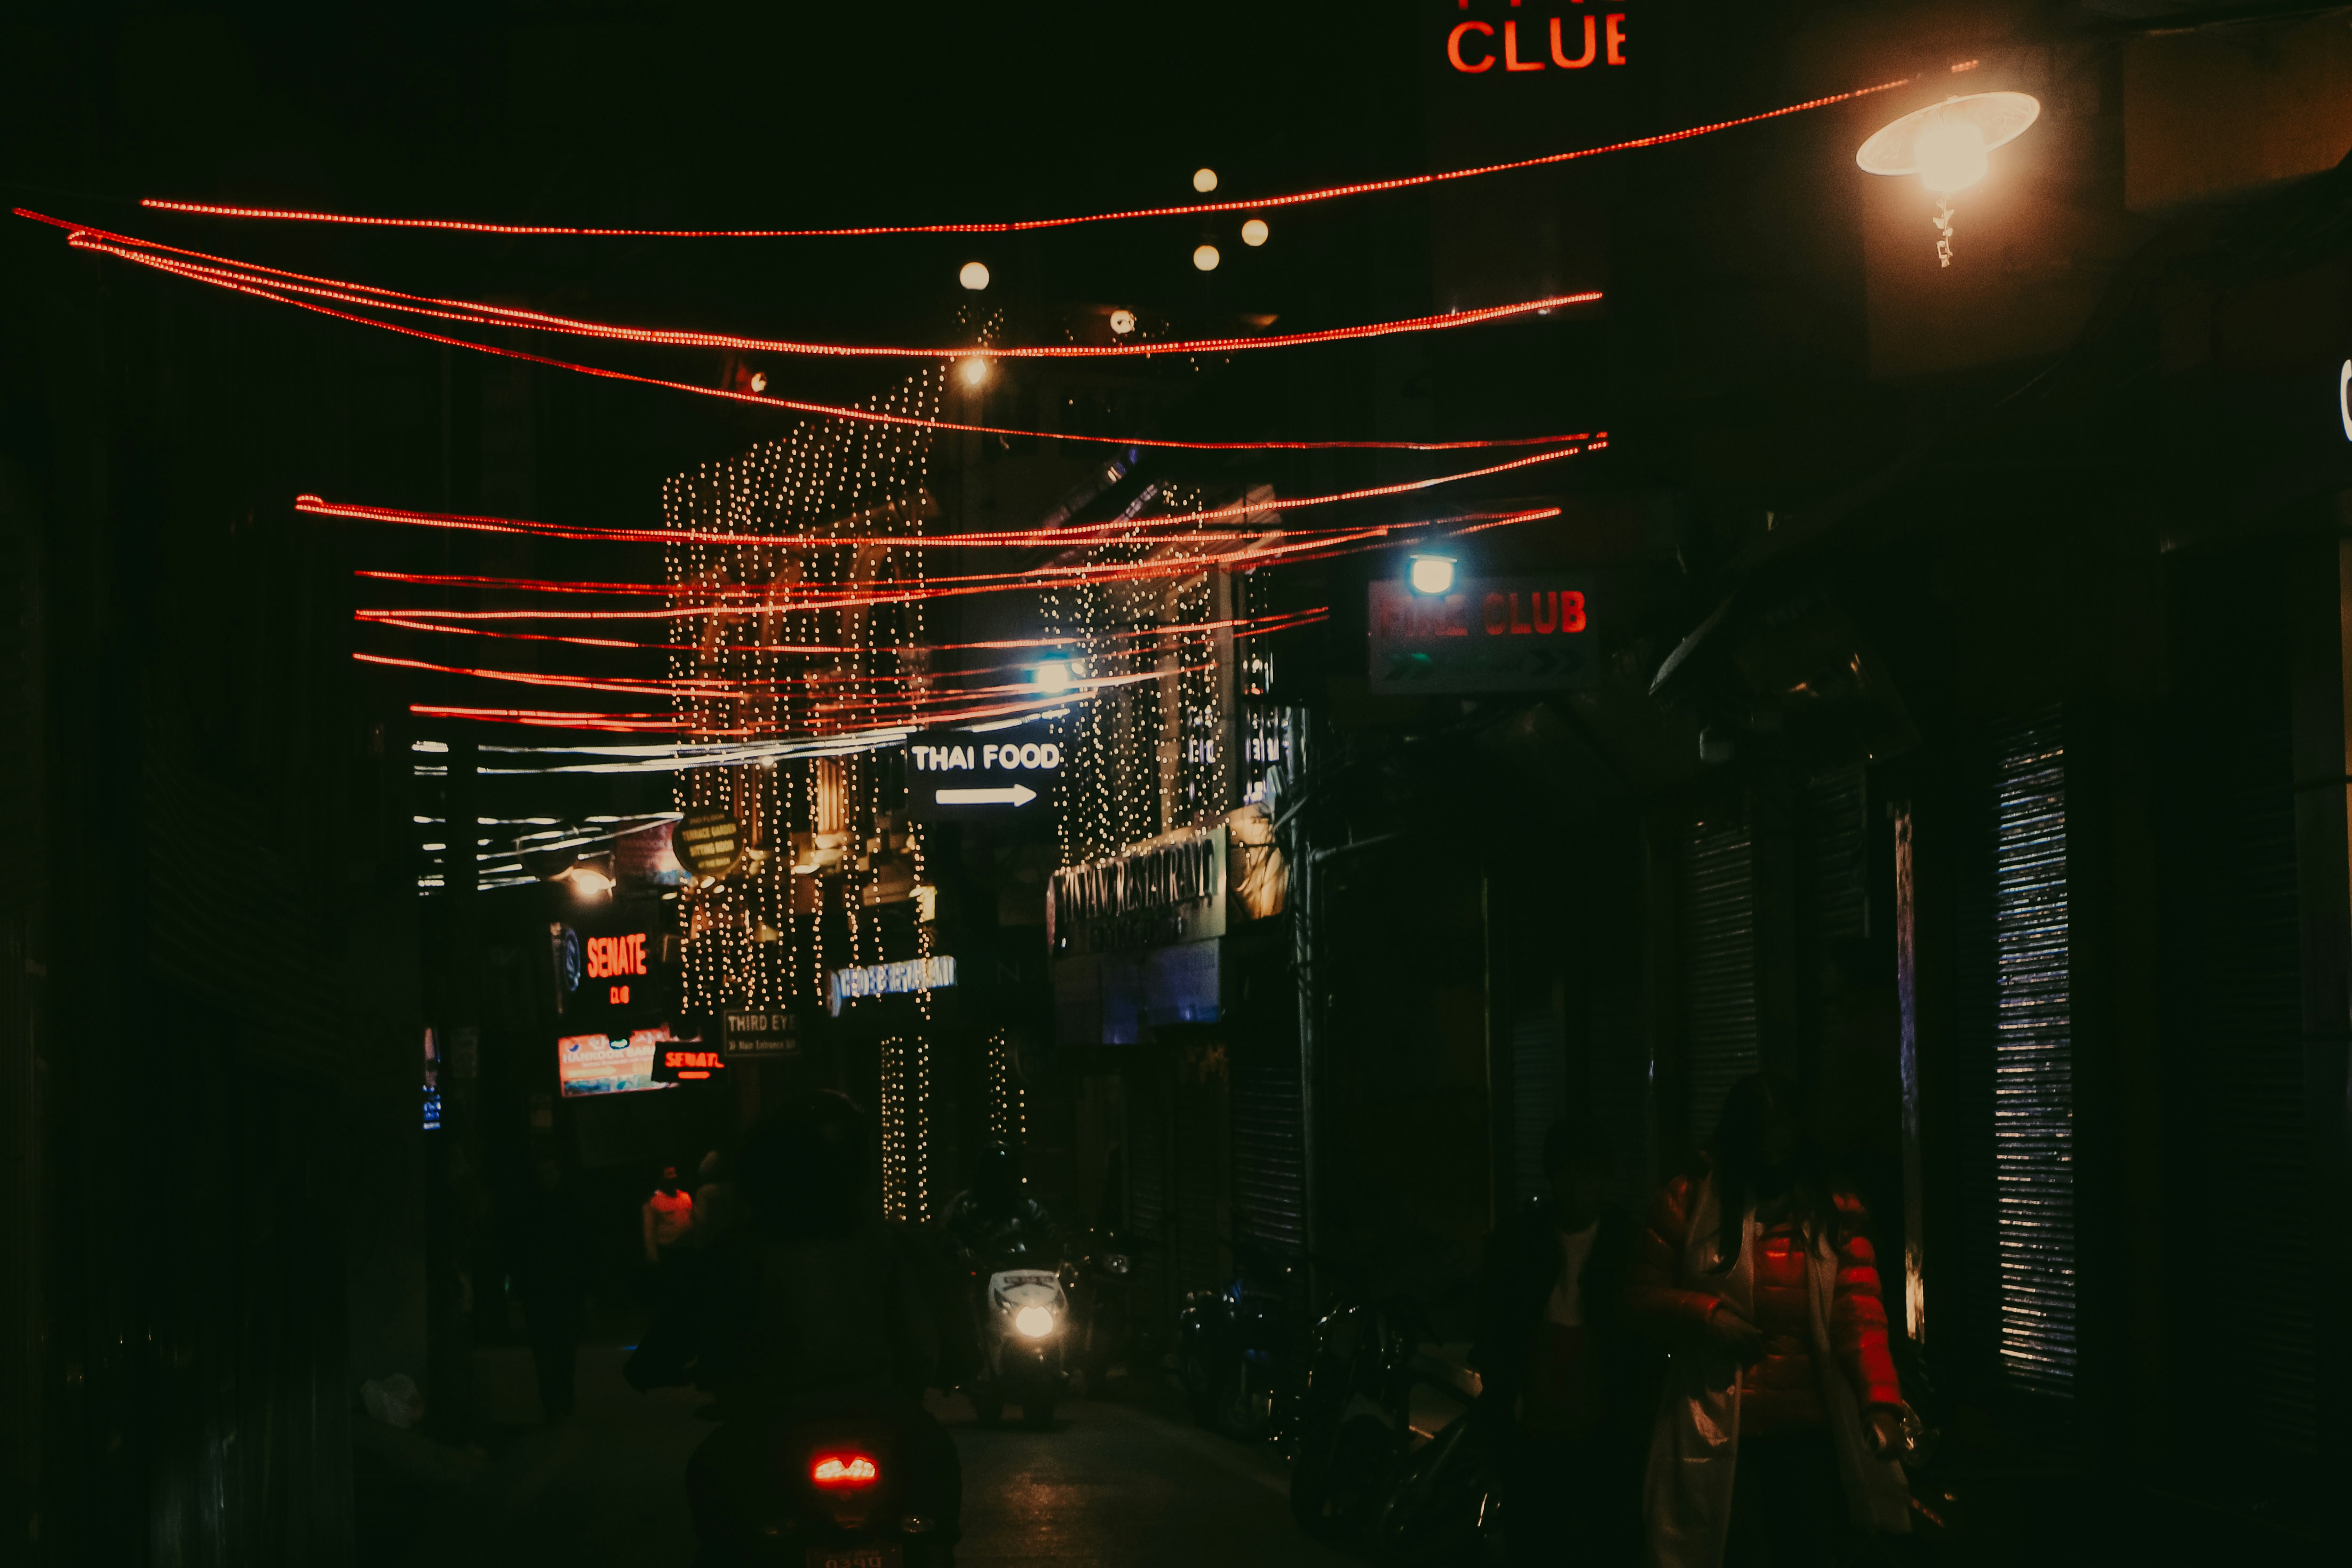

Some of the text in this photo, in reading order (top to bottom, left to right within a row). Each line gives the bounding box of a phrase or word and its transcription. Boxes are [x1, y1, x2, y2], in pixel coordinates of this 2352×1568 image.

[1483, 590, 1587, 635] CLUB
[911, 743, 1060, 771] THAI FOOD
[587, 933, 647, 978] SENATE
[728, 1014, 796, 1032] THIRD EYE
